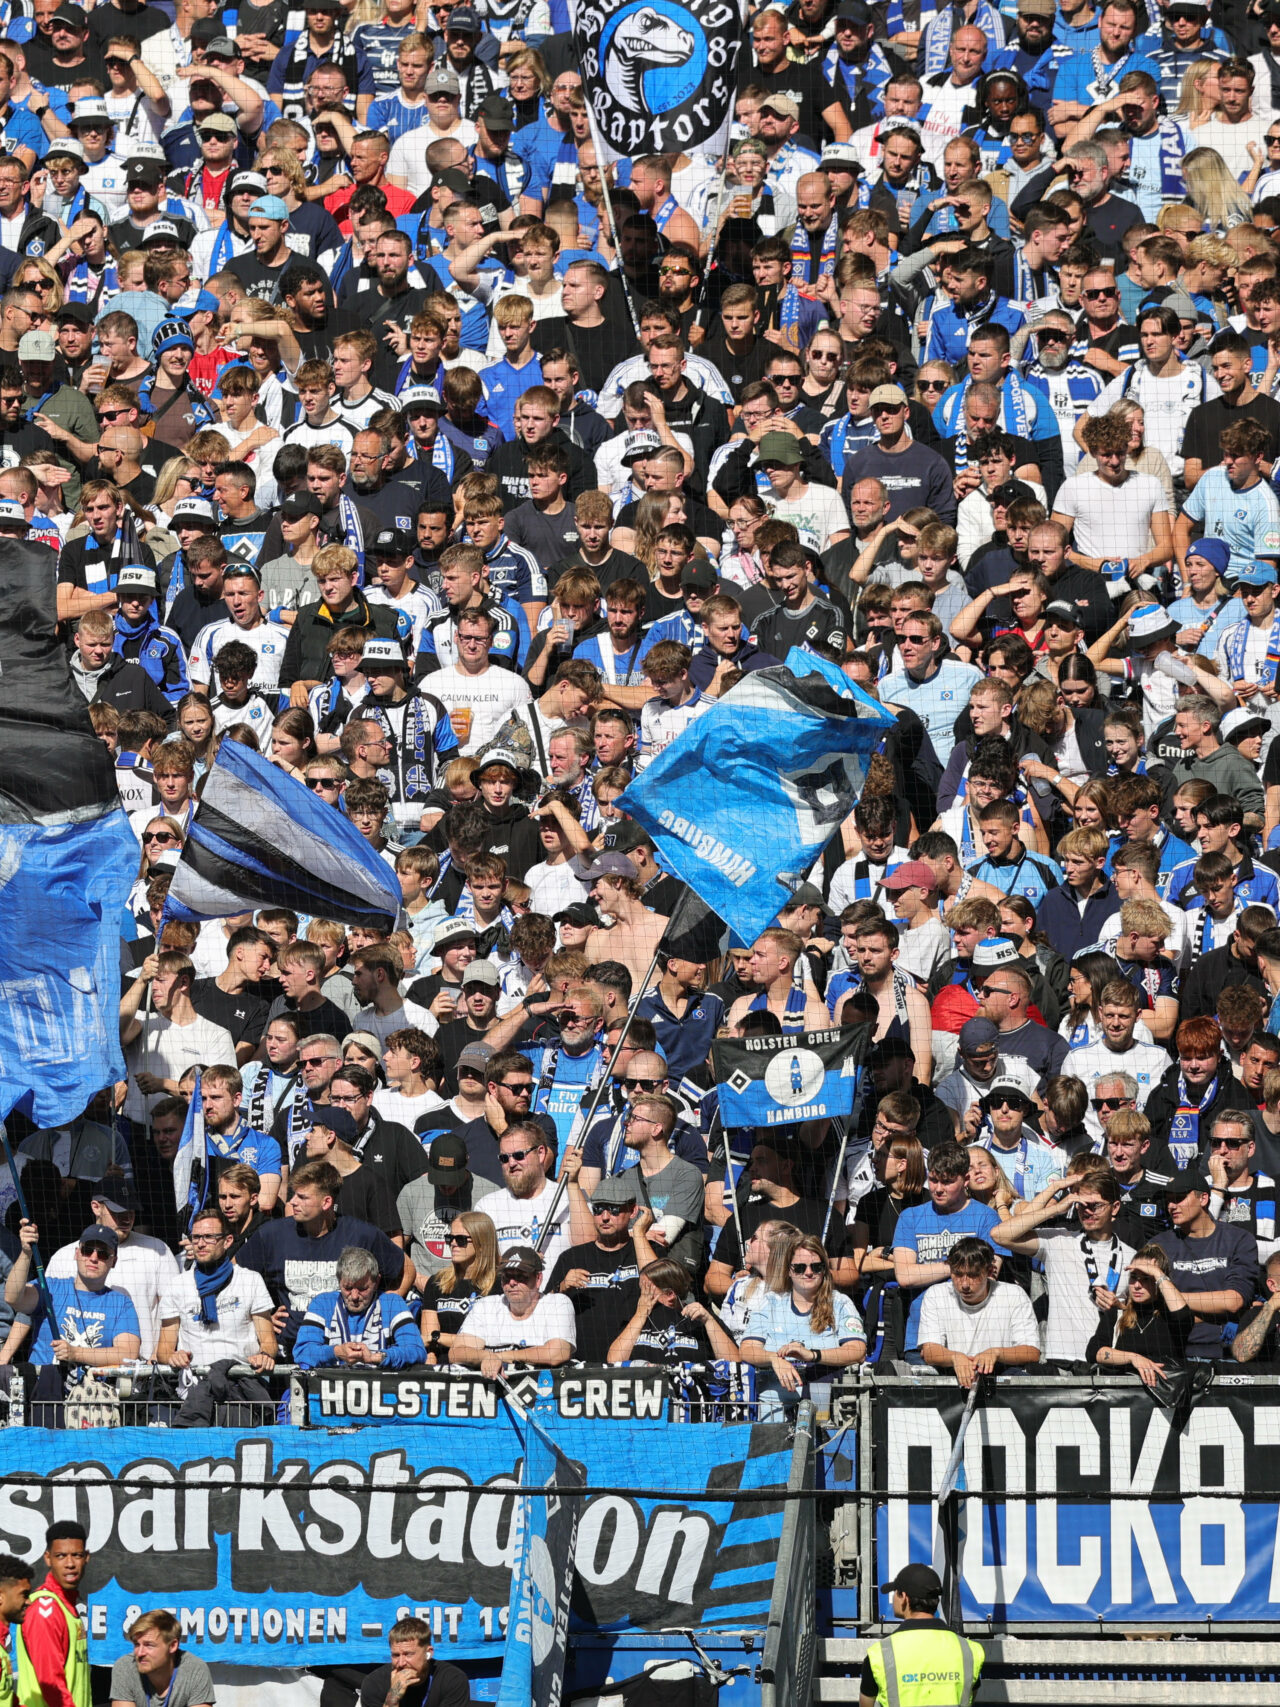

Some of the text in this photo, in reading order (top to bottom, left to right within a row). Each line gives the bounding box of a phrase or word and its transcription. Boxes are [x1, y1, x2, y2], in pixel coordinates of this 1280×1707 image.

[707, 36, 742, 71] 87
[592, 76, 729, 152] Raptors
[122, 573, 144, 582] HSV
[368, 646, 392, 655] HSV
[440, 694, 499, 703] CALVIN KLEIN
[745, 1030, 842, 1051] HOLSTEN CREW
[558, 1090, 579, 1102] Fly
[548, 1101, 578, 1114] mira
[766, 1103, 827, 1125] HAMBURG
[320, 1378, 663, 1419] HOLSTEN CREW
[886, 1406, 1280, 1605] DOCK8
[920, 1671, 961, 1682] POWER
